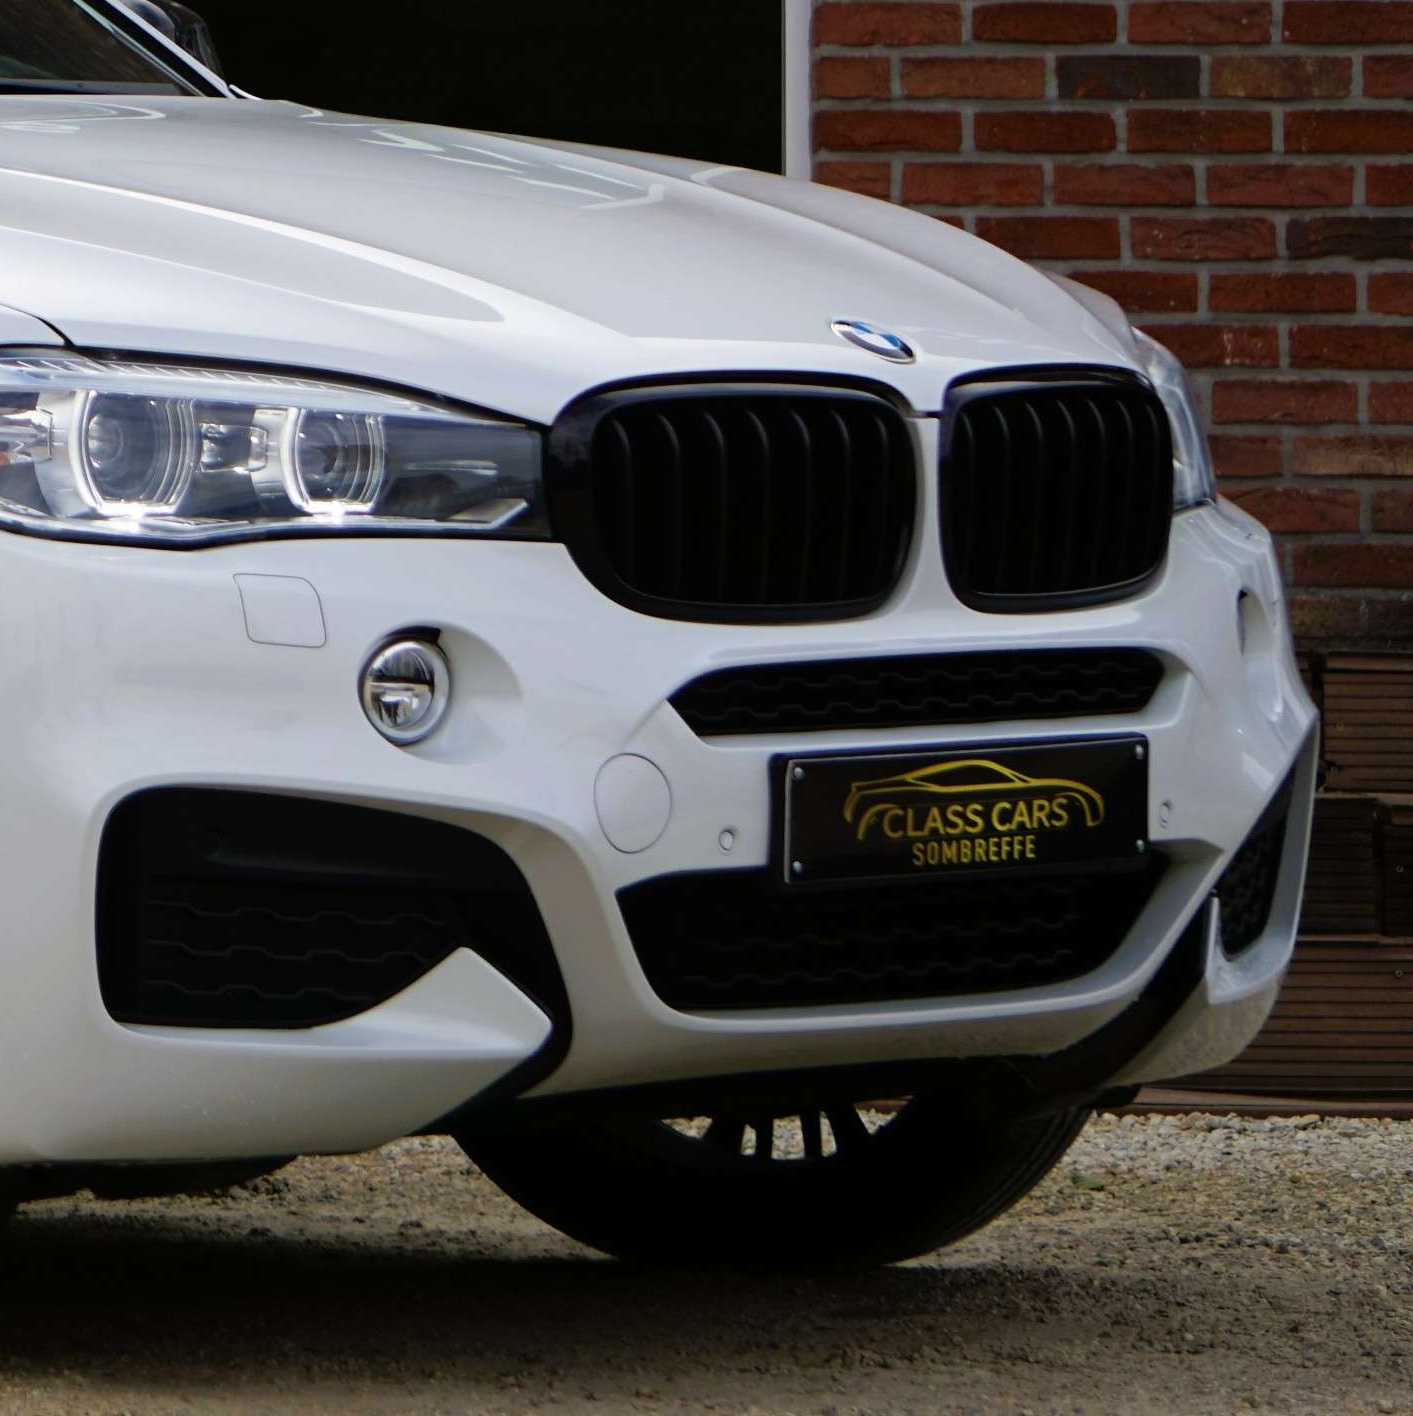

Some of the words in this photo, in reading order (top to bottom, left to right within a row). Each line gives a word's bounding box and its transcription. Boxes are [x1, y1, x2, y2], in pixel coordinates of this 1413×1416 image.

[882, 803, 985, 839] CLASS
[990, 797, 1069, 832] CARS
[911, 834, 1037, 867] SOMBREFFE
